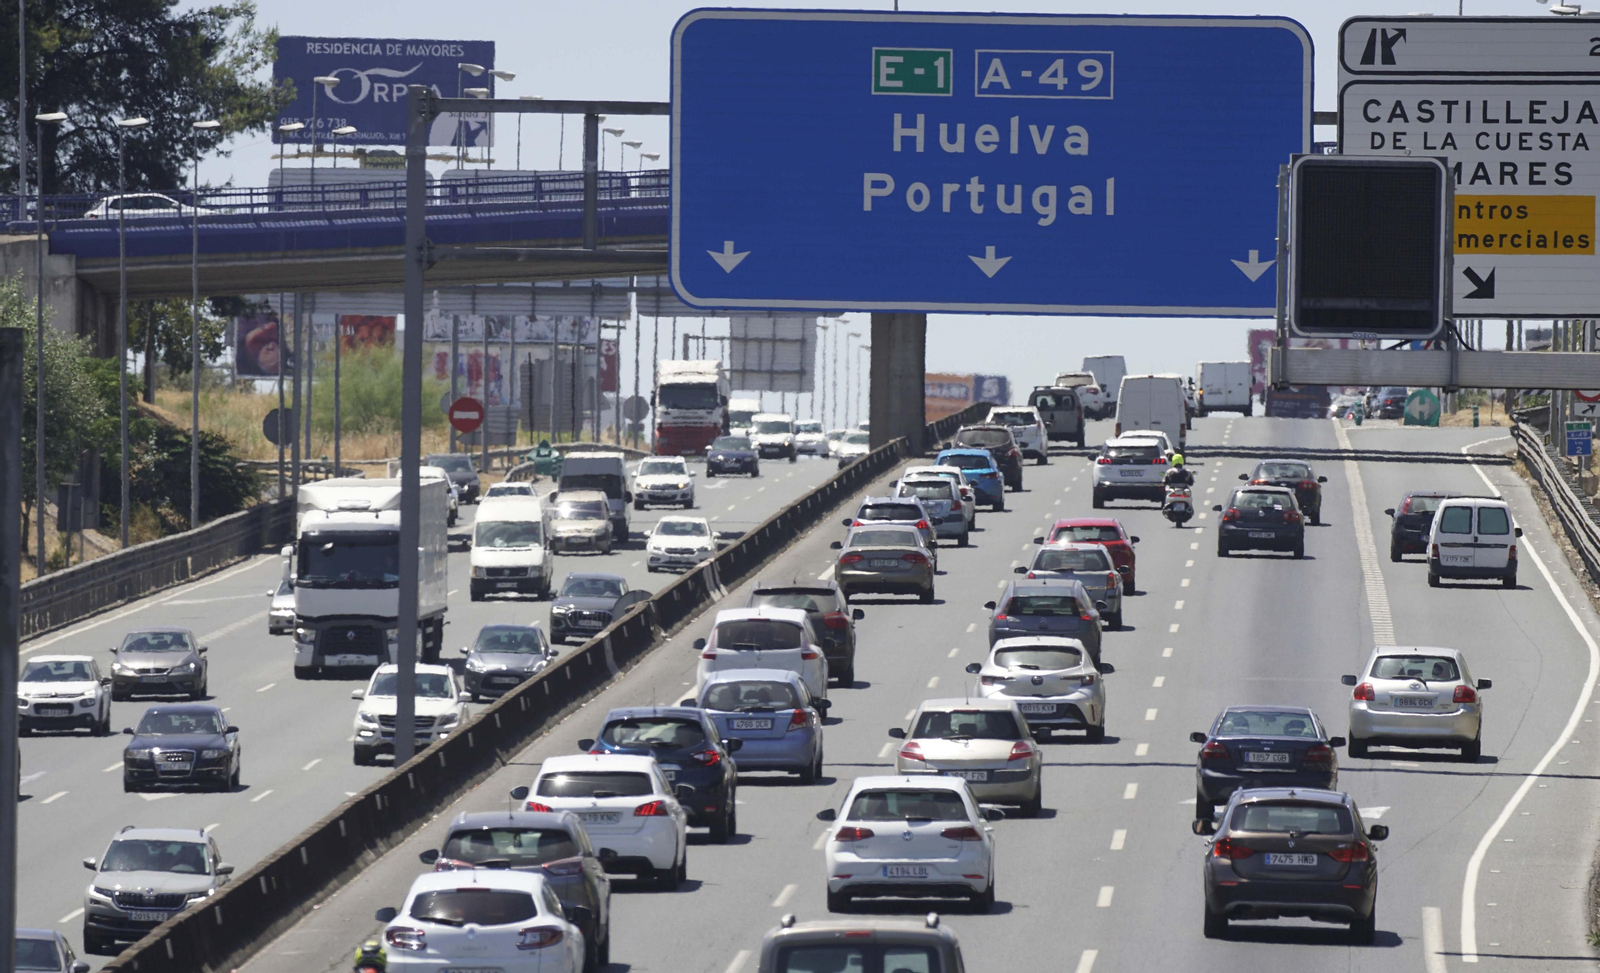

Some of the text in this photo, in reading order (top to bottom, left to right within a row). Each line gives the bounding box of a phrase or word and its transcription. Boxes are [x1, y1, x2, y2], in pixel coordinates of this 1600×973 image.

[306, 42, 465, 57] RESIDENCIA DE MAYORES
[879, 55, 945, 88] E-1
[980, 58, 1104, 91] A-49
[324, 66, 442, 105] ORPA
[1362, 98, 1599, 124] CASTILLEJA
[327, 117, 348, 128] 738
[893, 113, 1090, 156] Huelva
[1370, 131, 1590, 152] DE LA CUESTA
[863, 172, 1115, 227] Portugal
[1458, 229, 1590, 249] merciales
[1575, 446, 1583, 454] 2
[1272, 854, 1294, 864] 7475
[889, 866, 930, 875] 4194 LBL
